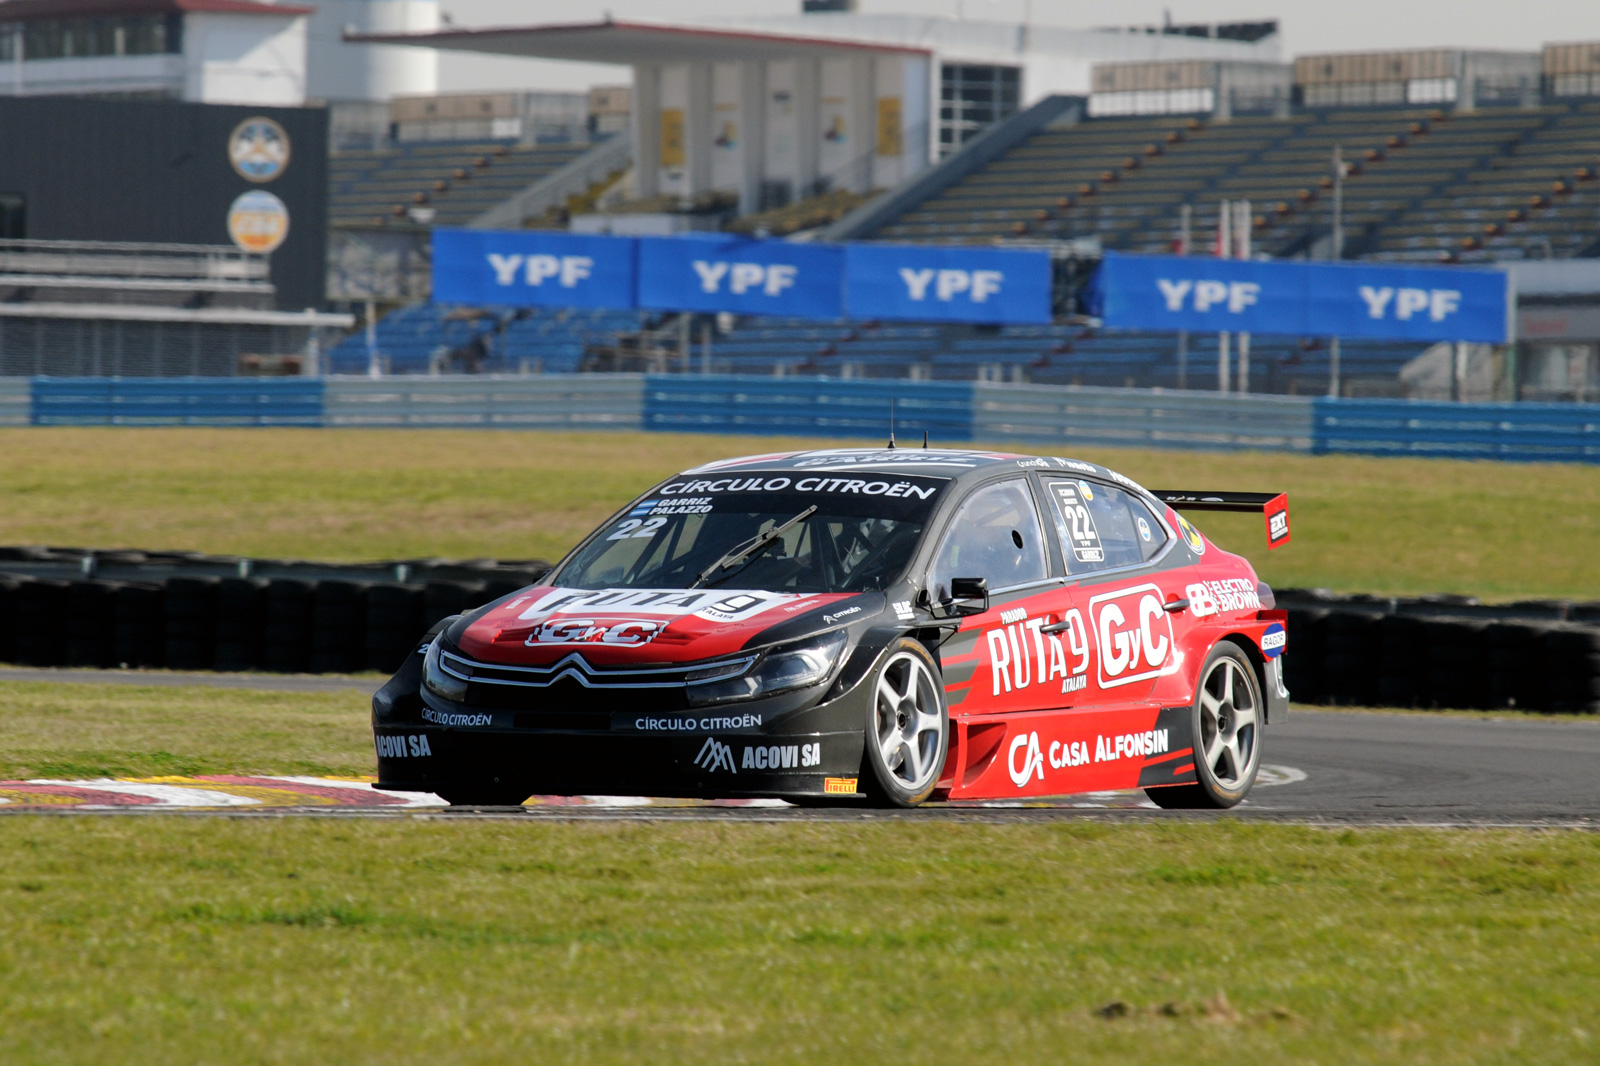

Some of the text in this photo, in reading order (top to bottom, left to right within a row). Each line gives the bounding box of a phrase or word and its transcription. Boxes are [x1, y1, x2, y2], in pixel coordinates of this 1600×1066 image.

[486, 254, 593, 287] YPF
[693, 260, 797, 295] YPF
[900, 267, 1003, 302] YPF
[1157, 278, 1261, 313] YPF
[1359, 286, 1461, 321] YPF
[660, 477, 936, 500] CÍRCULO CITROËN
[649, 505, 713, 515] PALAZZO
[658, 497, 713, 507] GARRIZ
[606, 517, 668, 541] 22
[1064, 505, 1097, 541] 22
[1211, 578, 1254, 594] ELECTRO
[1221, 590, 1261, 613] BROWN
[1100, 594, 1168, 677] GyC
[987, 607, 1090, 696] RUTA 9
[448, 713, 492, 726] CITROËN
[636, 714, 762, 731] CÍRCULO CITROËN
[408, 734, 432, 757] SA
[742, 743, 821, 769] ACOVI SA
